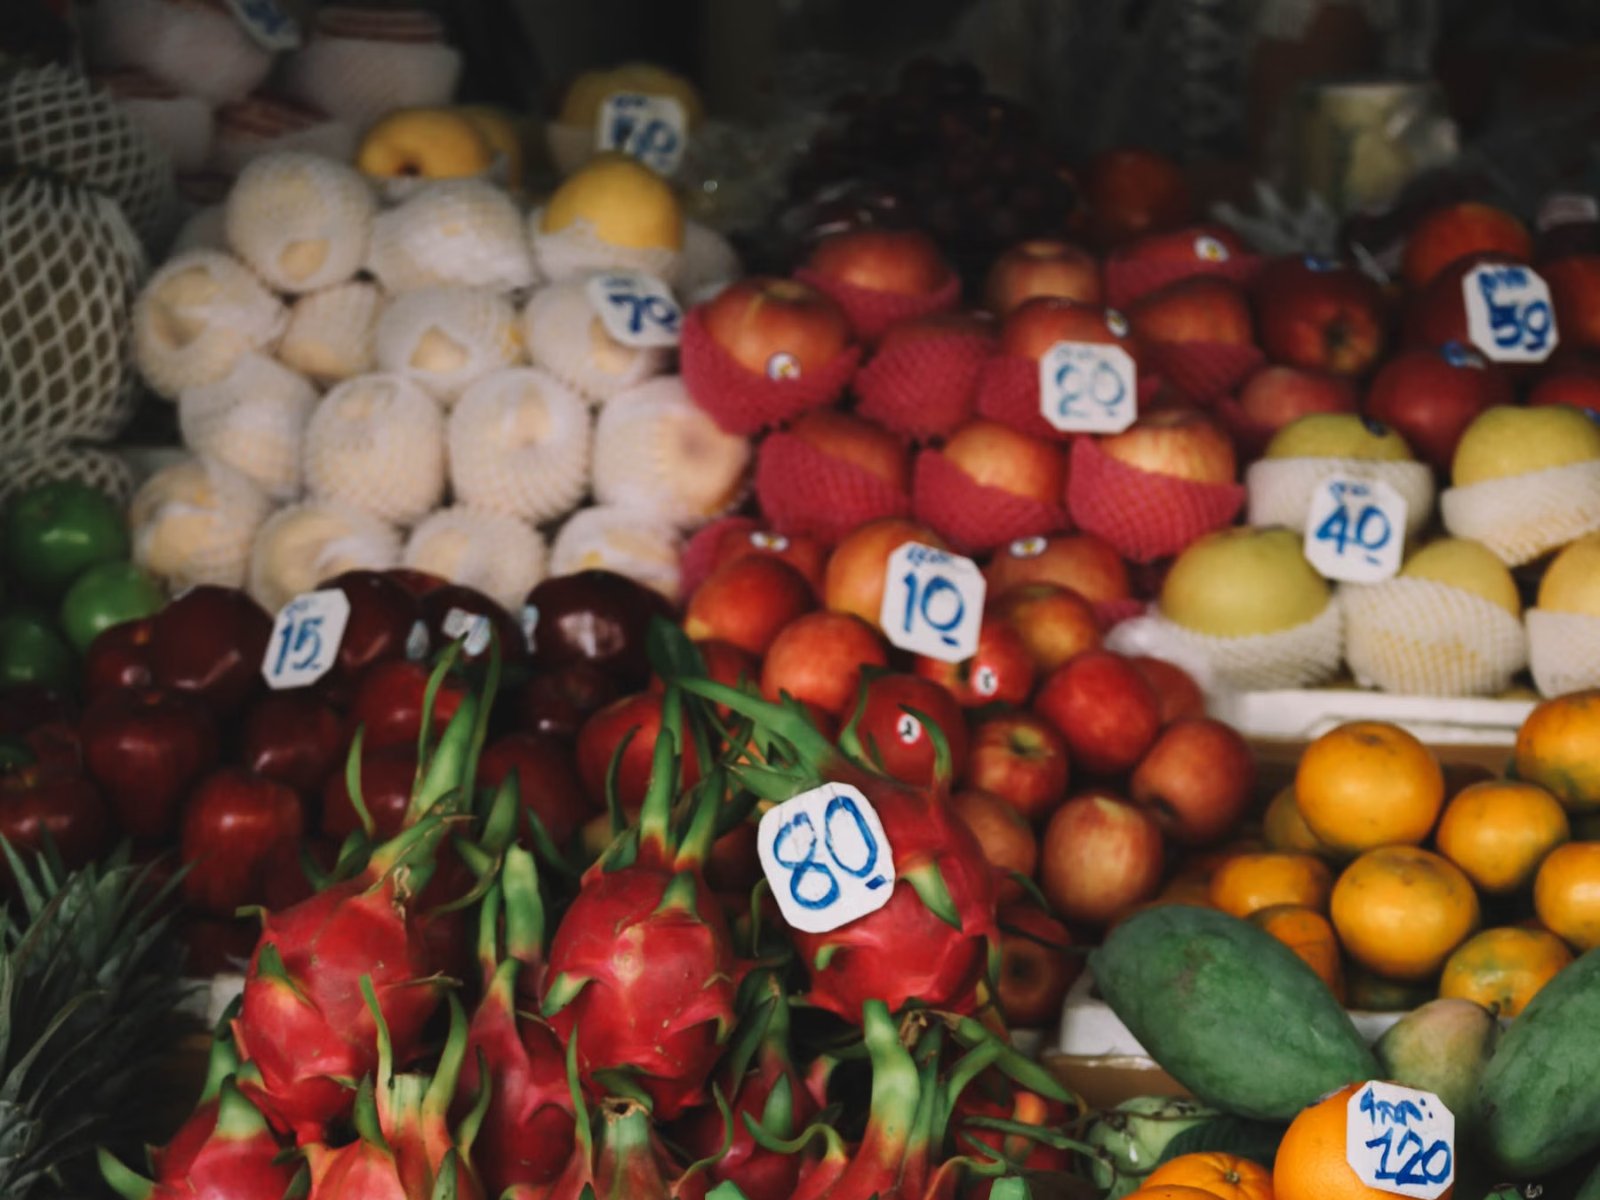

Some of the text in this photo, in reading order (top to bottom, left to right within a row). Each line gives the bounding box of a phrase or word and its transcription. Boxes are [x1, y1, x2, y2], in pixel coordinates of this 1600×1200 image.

[607, 294, 679, 333] 70
[1055, 362, 1126, 417] 20
[1315, 505, 1392, 555] 40
[902, 571, 965, 638] 10
[273, 617, 325, 676] 15
[773, 795, 879, 911] 80
[1365, 1128, 1452, 1186] 120
